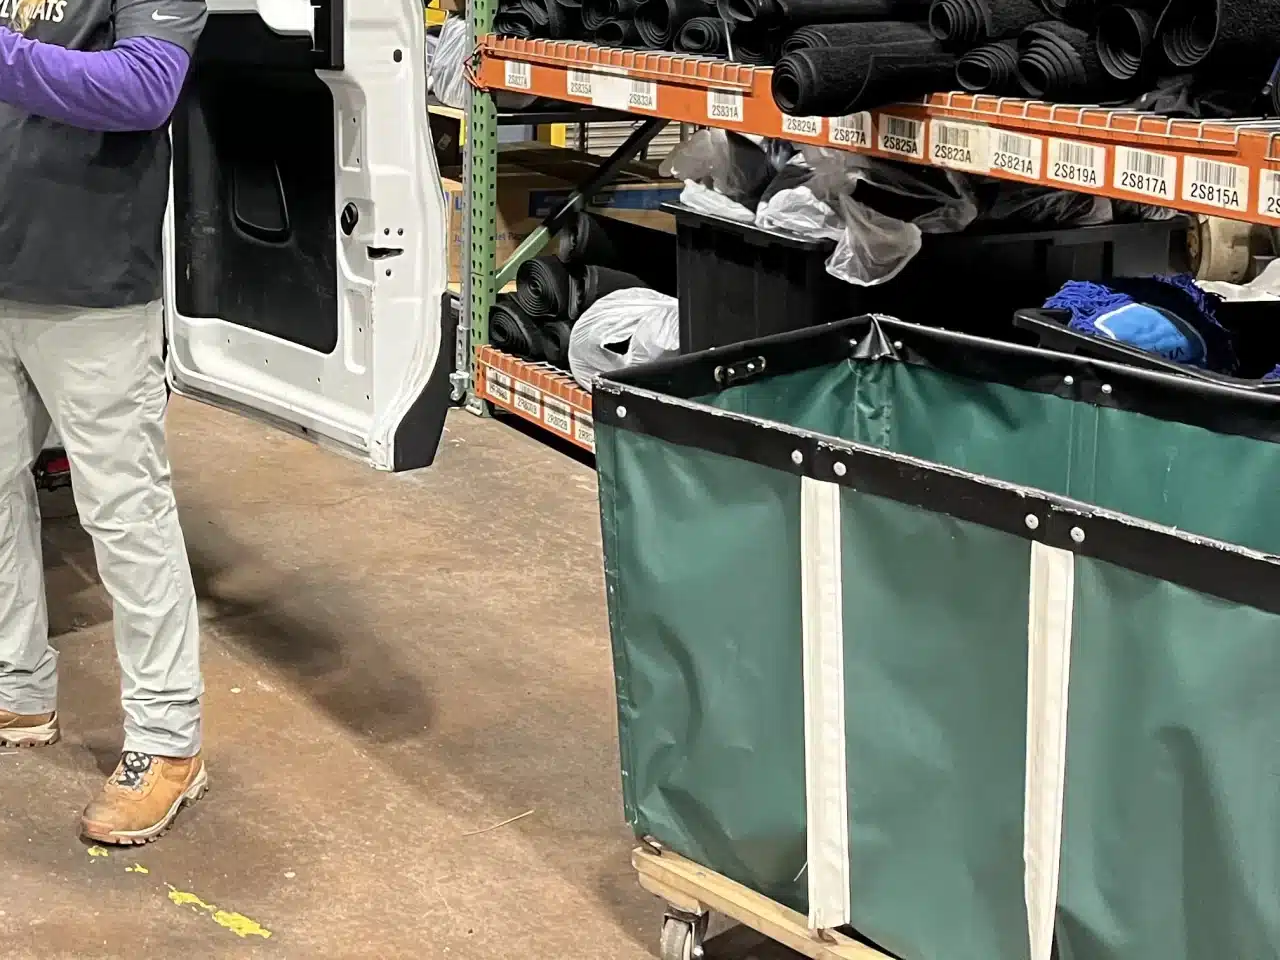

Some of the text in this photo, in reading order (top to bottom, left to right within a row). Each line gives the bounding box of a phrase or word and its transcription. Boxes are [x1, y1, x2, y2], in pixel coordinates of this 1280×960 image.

[629, 93, 653, 107] 2S833A
[711, 104, 739, 119] 2S831A
[787, 118, 817, 134] 2S829A
[833, 127, 867, 145] 2S827A
[883, 135, 918, 155] 2S825A
[934, 144, 972, 164] 2S823A
[993, 152, 1033, 175] 2S821A
[1054, 162, 1097, 185] 2S819A
[1121, 171, 1167, 195] 2S817A
[1190, 182, 1240, 207] 2S815A
